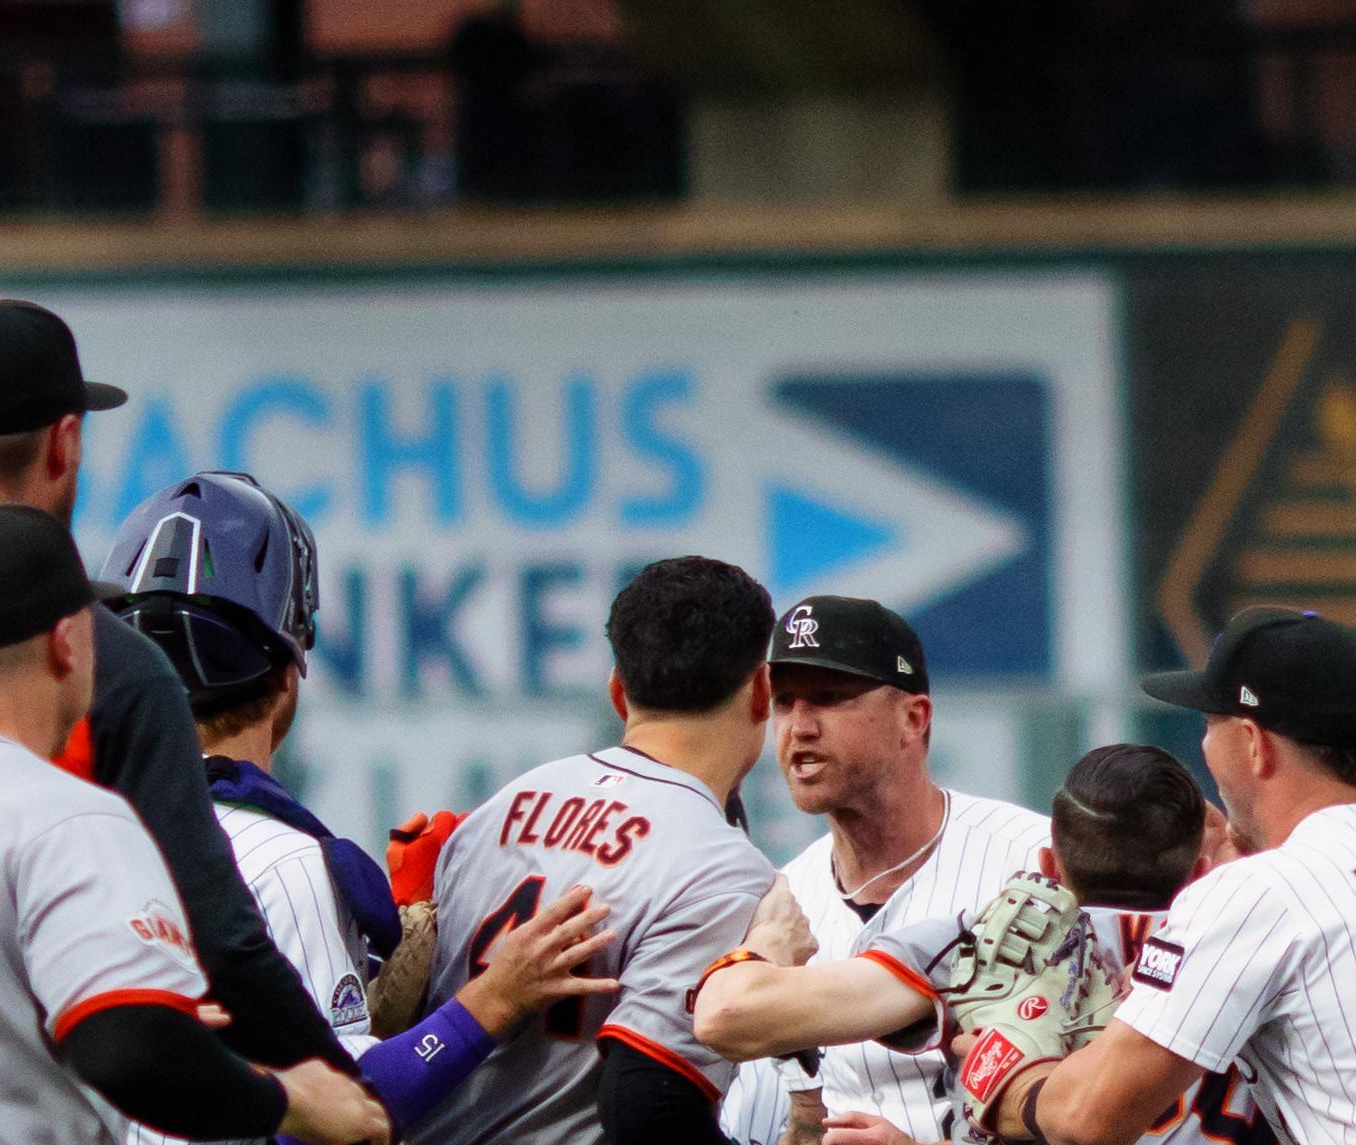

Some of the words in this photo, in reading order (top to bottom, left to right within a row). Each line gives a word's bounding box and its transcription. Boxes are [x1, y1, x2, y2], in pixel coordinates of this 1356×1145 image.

[76, 372, 706, 530] ACHUS
[499, 790, 652, 867] FLORES
[1139, 943, 1182, 977] YORK
